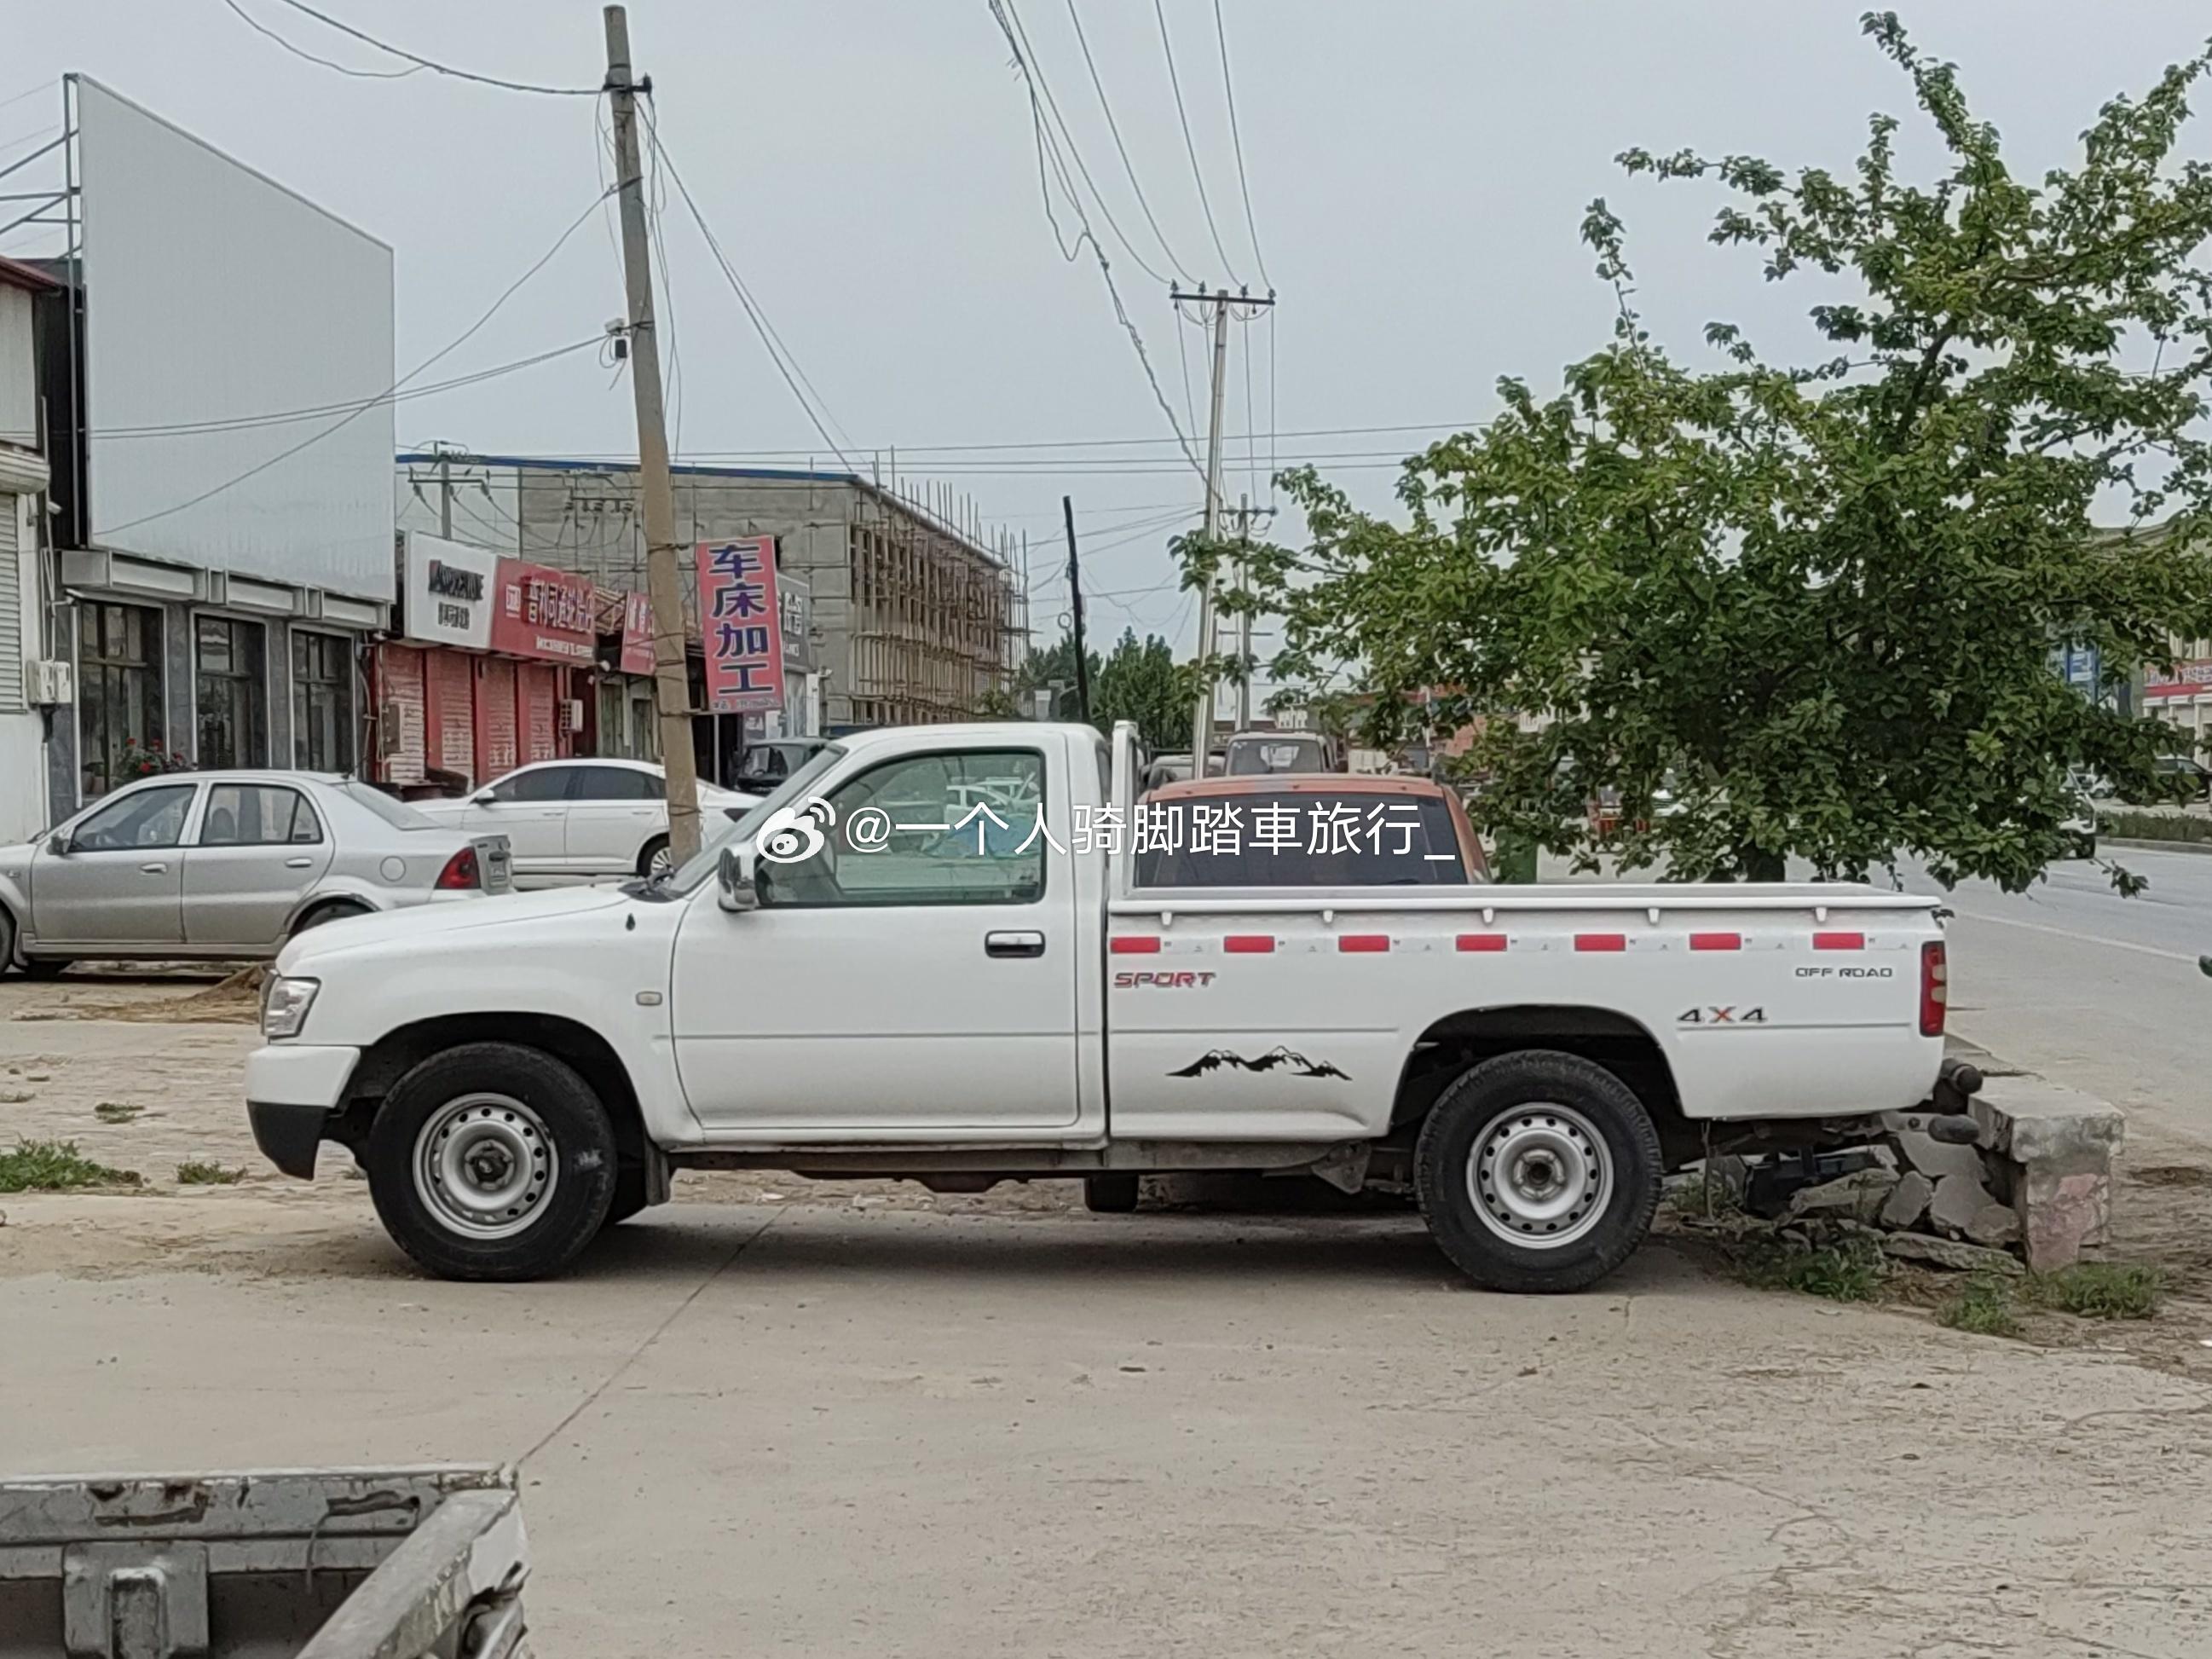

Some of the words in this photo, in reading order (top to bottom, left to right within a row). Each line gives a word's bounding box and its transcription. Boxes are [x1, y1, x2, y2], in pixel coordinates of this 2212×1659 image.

[708, 543, 774, 695] 车床加工
[1113, 972, 1216, 989] SPORT
[1795, 967, 1834, 978] OFF
[1839, 967, 1893, 978] ROAD
